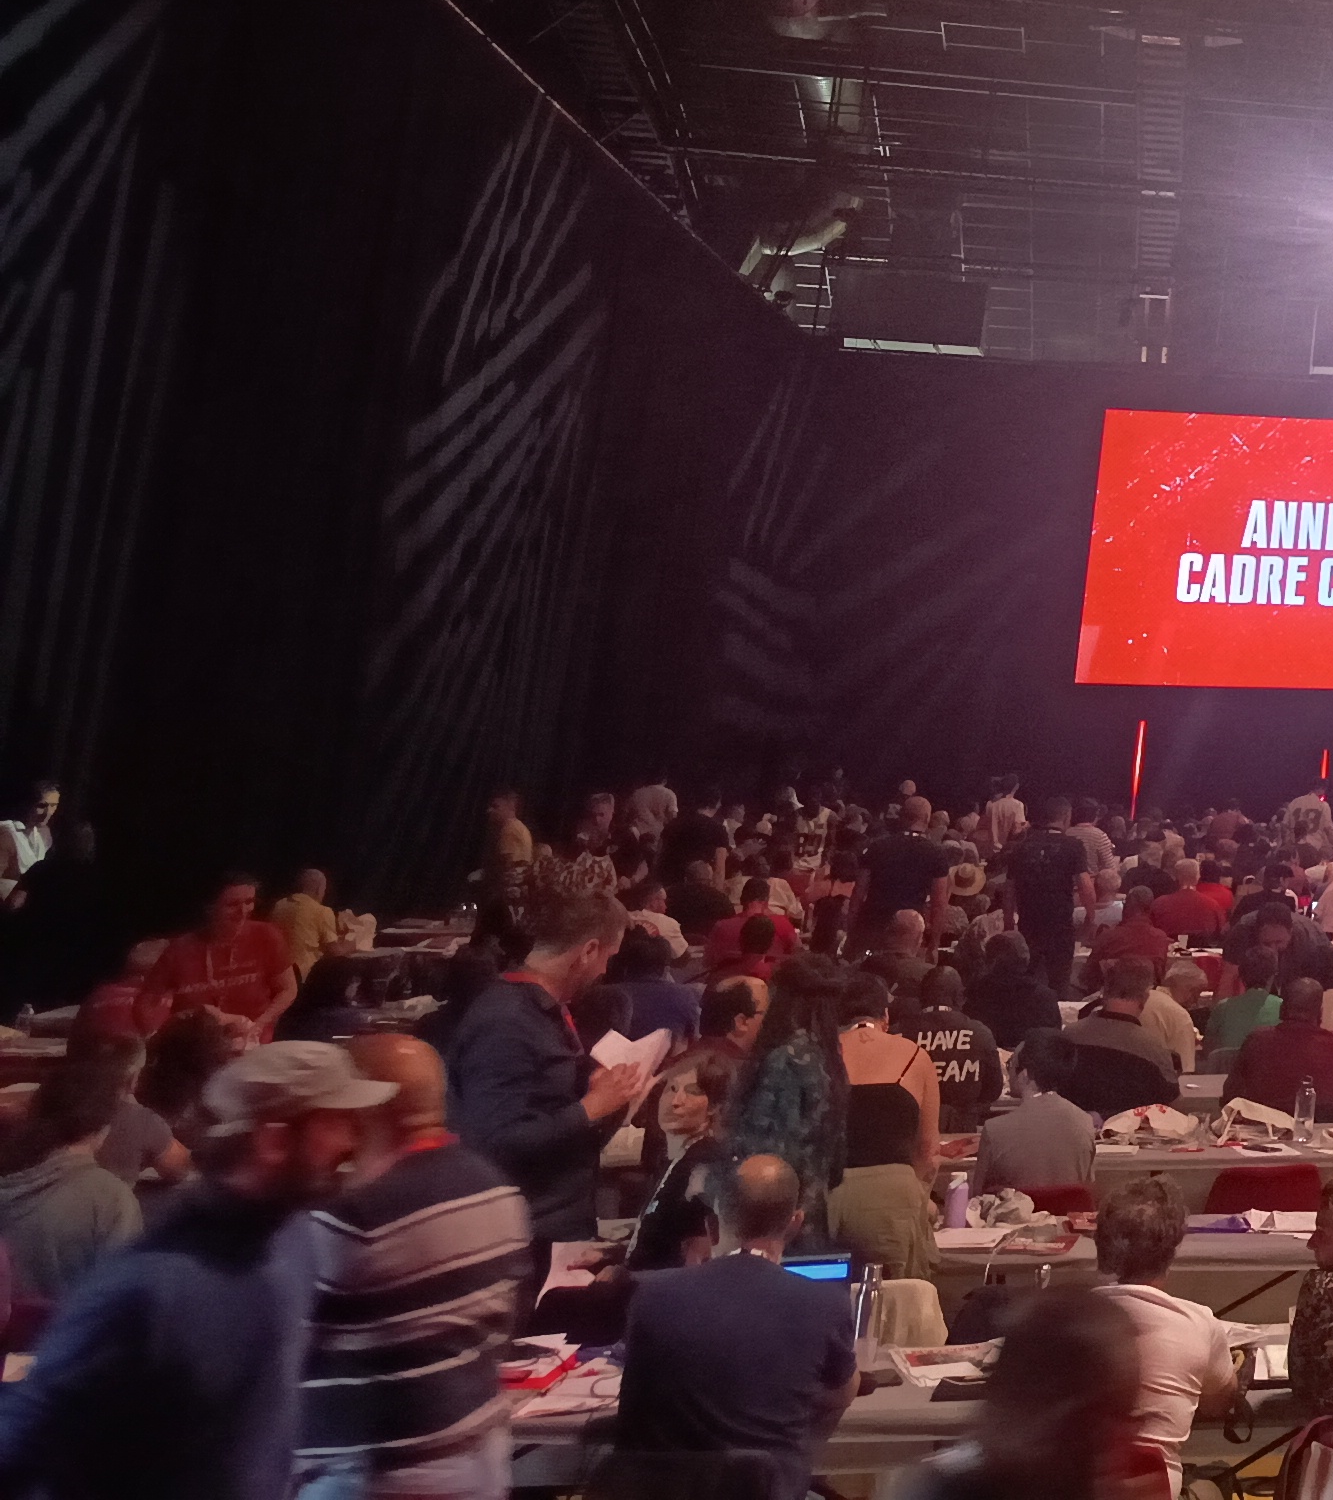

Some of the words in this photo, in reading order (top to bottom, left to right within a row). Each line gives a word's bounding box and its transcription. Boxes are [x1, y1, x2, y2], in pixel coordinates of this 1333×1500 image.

[1176, 553, 1306, 606] CADRE
[916, 1030, 974, 1051] HAVE
[934, 1059, 980, 1083] EAM
